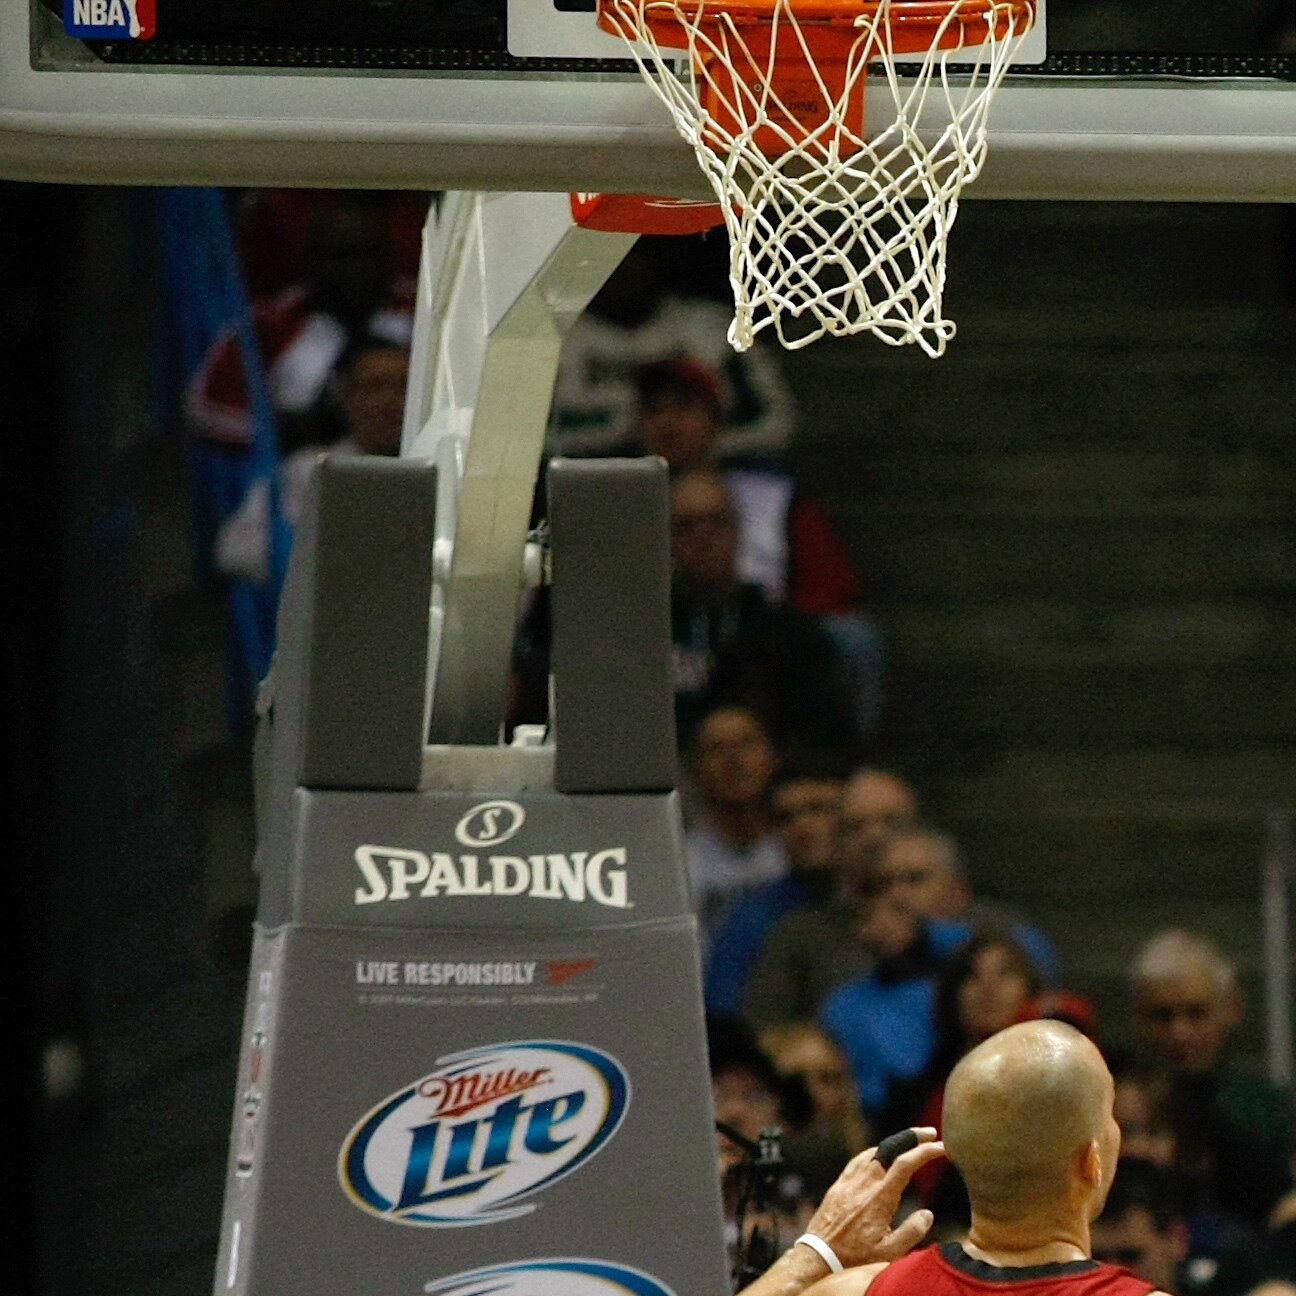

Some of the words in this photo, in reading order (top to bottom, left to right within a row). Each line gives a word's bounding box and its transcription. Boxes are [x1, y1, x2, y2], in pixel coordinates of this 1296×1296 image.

[73, 0, 126, 26] NBA
[354, 844, 629, 908] SPALDING
[356, 961, 399, 985] LIVE
[404, 961, 537, 986] RESPONSIBLY
[417, 1066, 553, 1114] Miller
[400, 1089, 586, 1209] Lite
